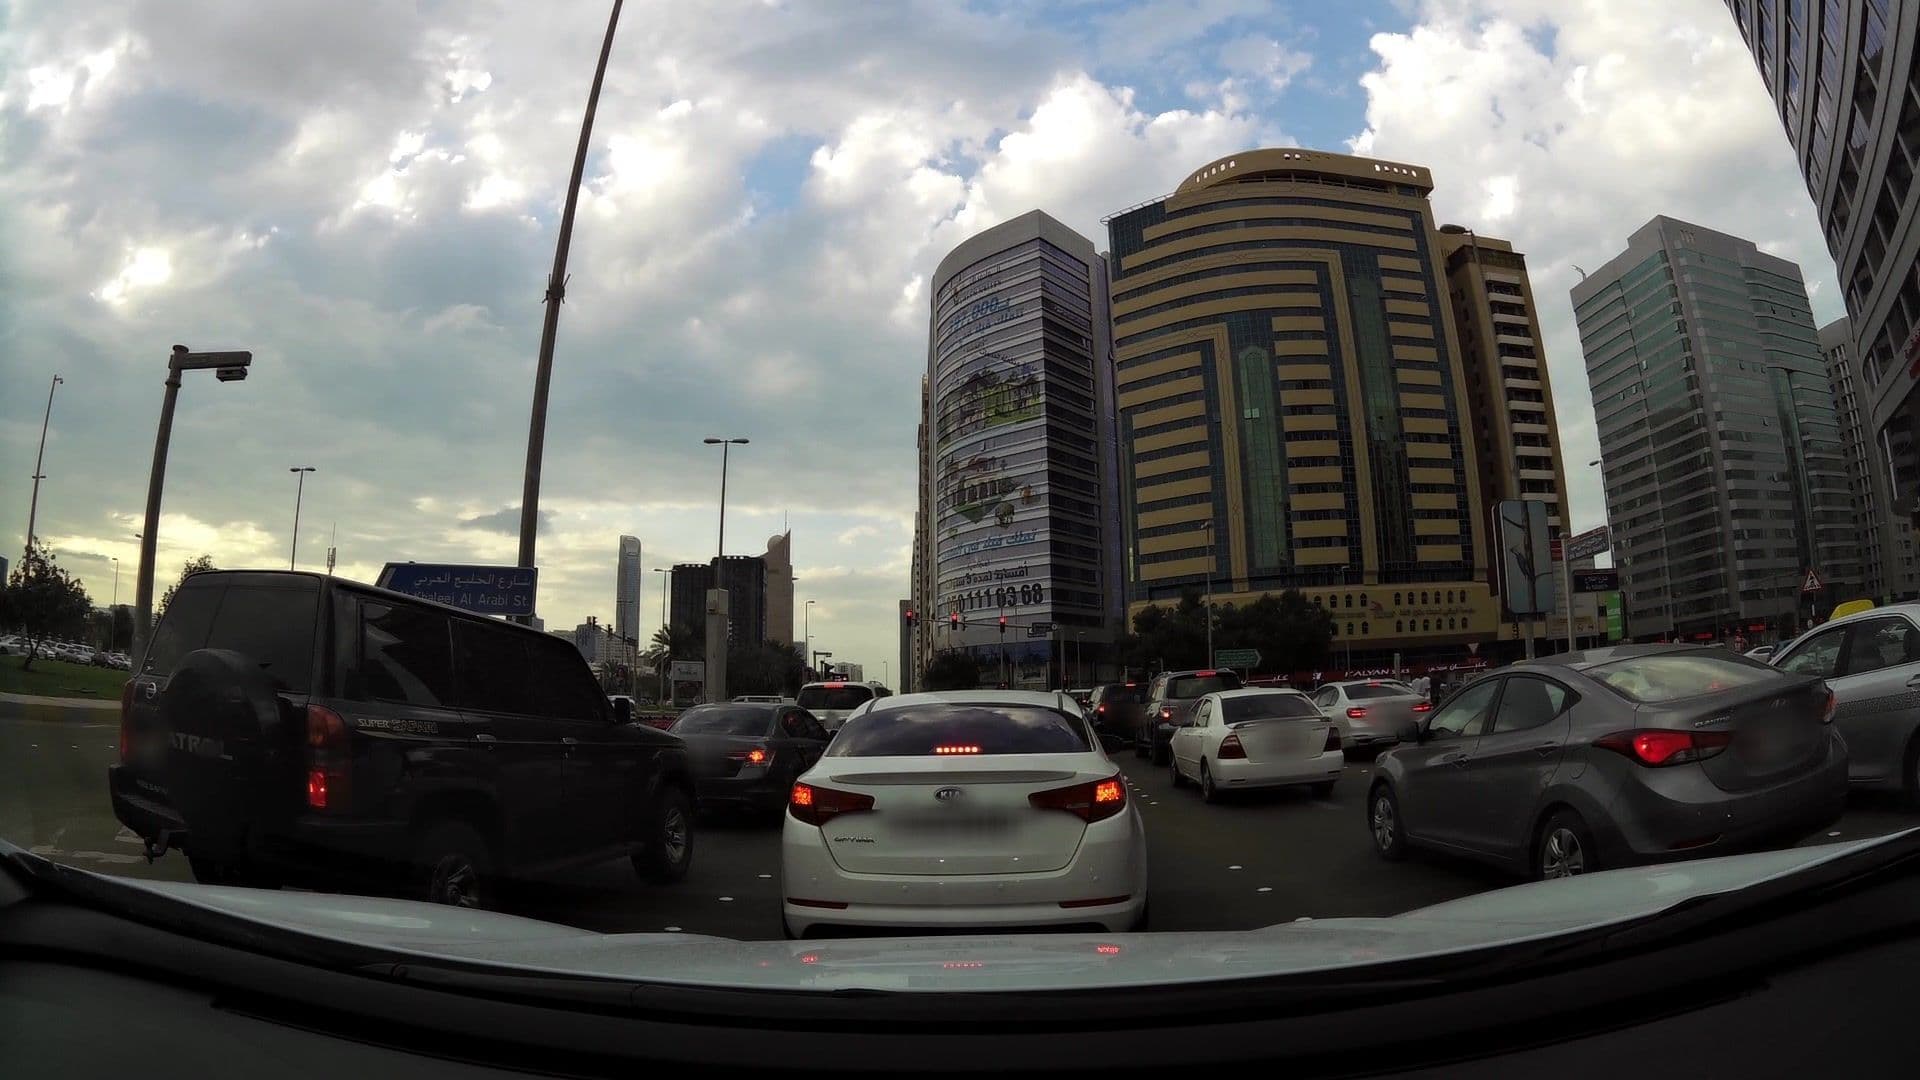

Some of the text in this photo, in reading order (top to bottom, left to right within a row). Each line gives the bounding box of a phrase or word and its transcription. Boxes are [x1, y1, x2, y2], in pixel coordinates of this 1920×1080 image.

[497, 575, 530, 589] شارع
[460, 593, 472, 605] Al
[478, 594, 509, 606] Arabi
[513, 595, 530, 607] St.
[357, 718, 439, 734] SUPER SAFARI
[940, 791, 961, 799] KIA
